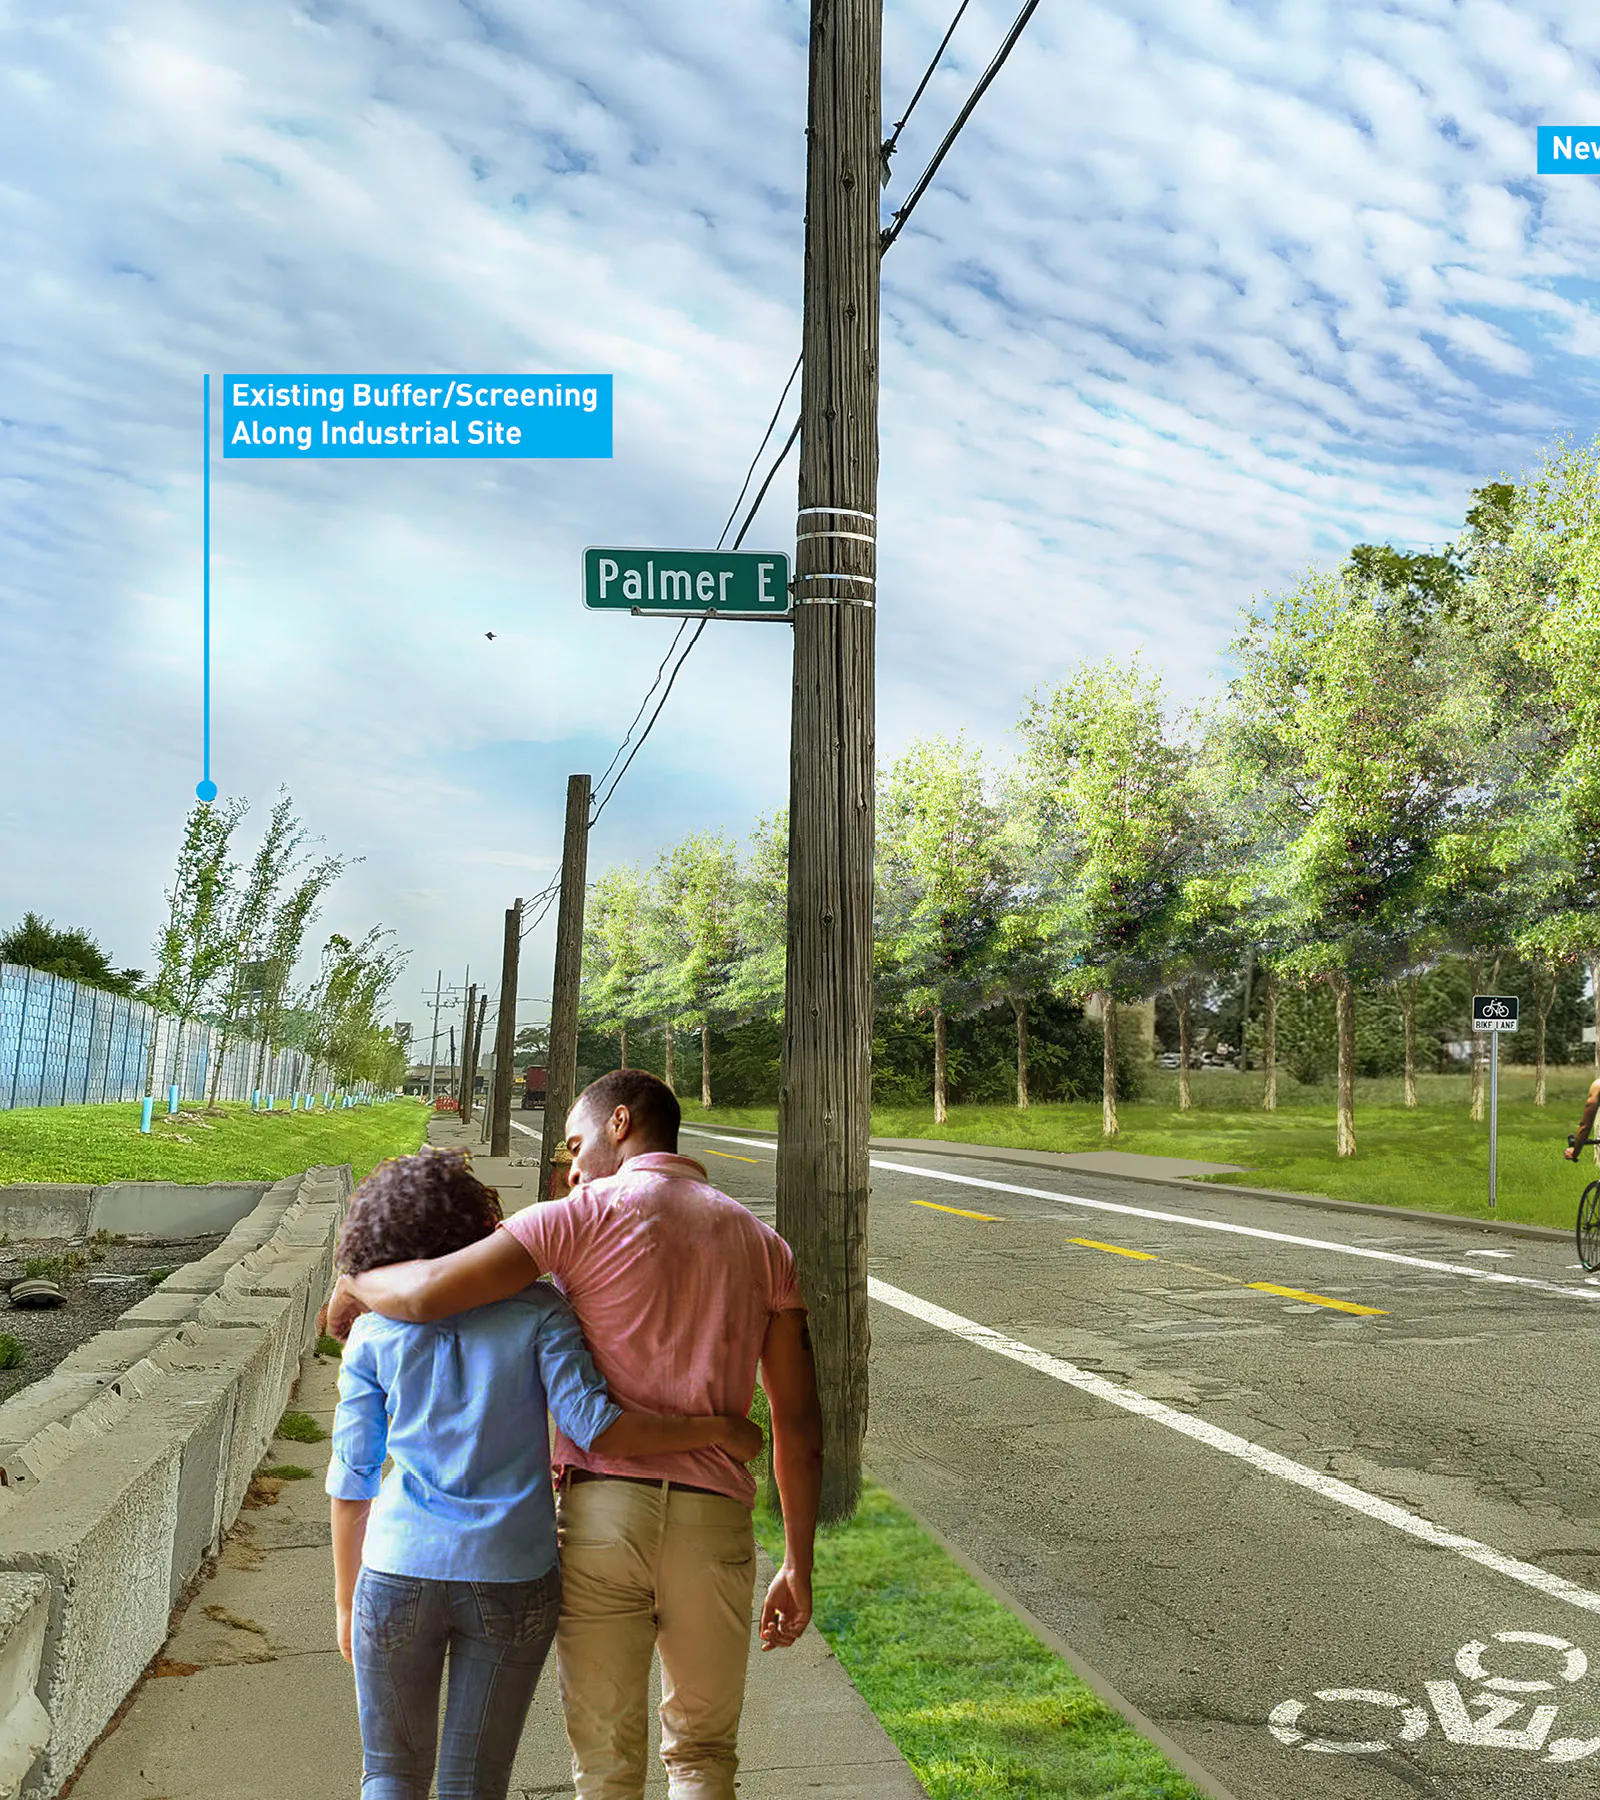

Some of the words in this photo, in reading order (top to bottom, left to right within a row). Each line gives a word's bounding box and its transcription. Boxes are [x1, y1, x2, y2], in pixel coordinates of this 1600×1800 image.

[599, 559, 733, 601] Palmer
[758, 563, 775, 602] E
[1475, 1021, 1493, 1029] BIKE
[1496, 1021, 1516, 1029] LANE
